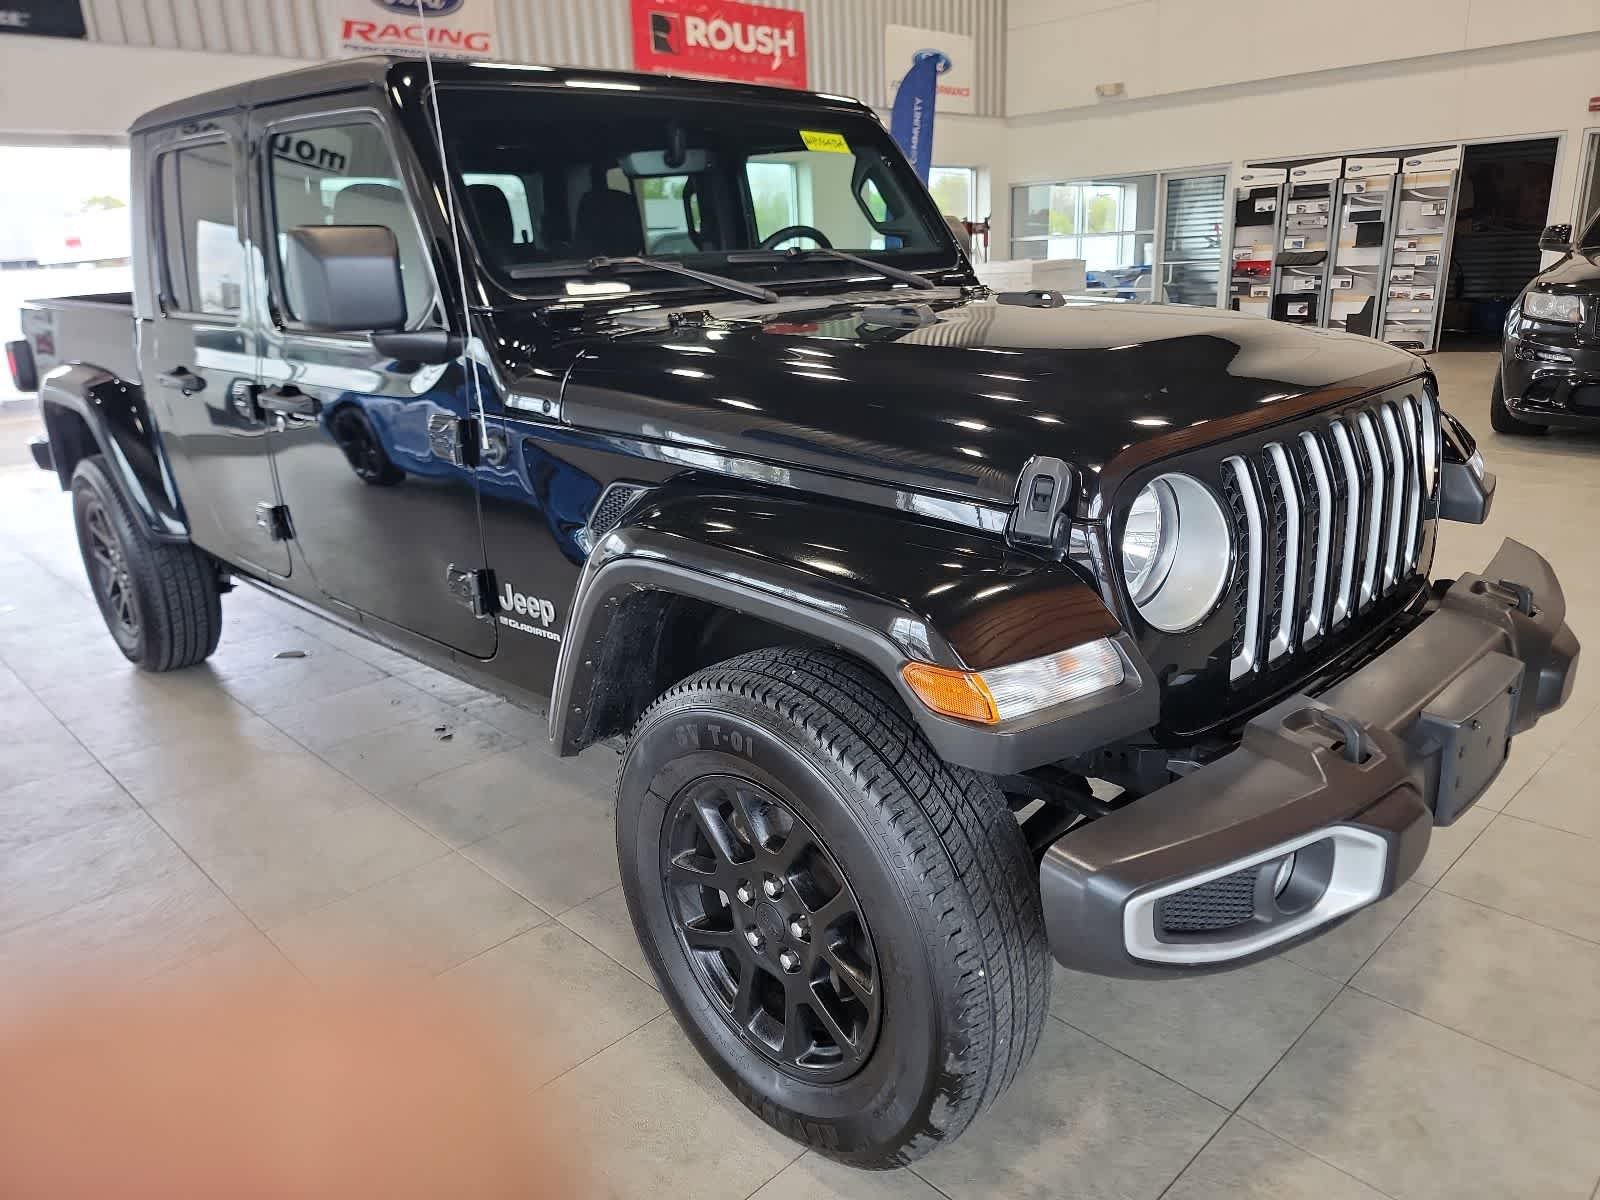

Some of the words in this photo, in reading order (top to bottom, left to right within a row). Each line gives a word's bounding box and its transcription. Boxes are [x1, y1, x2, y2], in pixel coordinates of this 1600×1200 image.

[342, 19, 491, 52] RACING
[684, 15, 796, 71] ROUSH
[498, 583, 556, 627] Jeep
[508, 618, 561, 642] GLADIATOR
